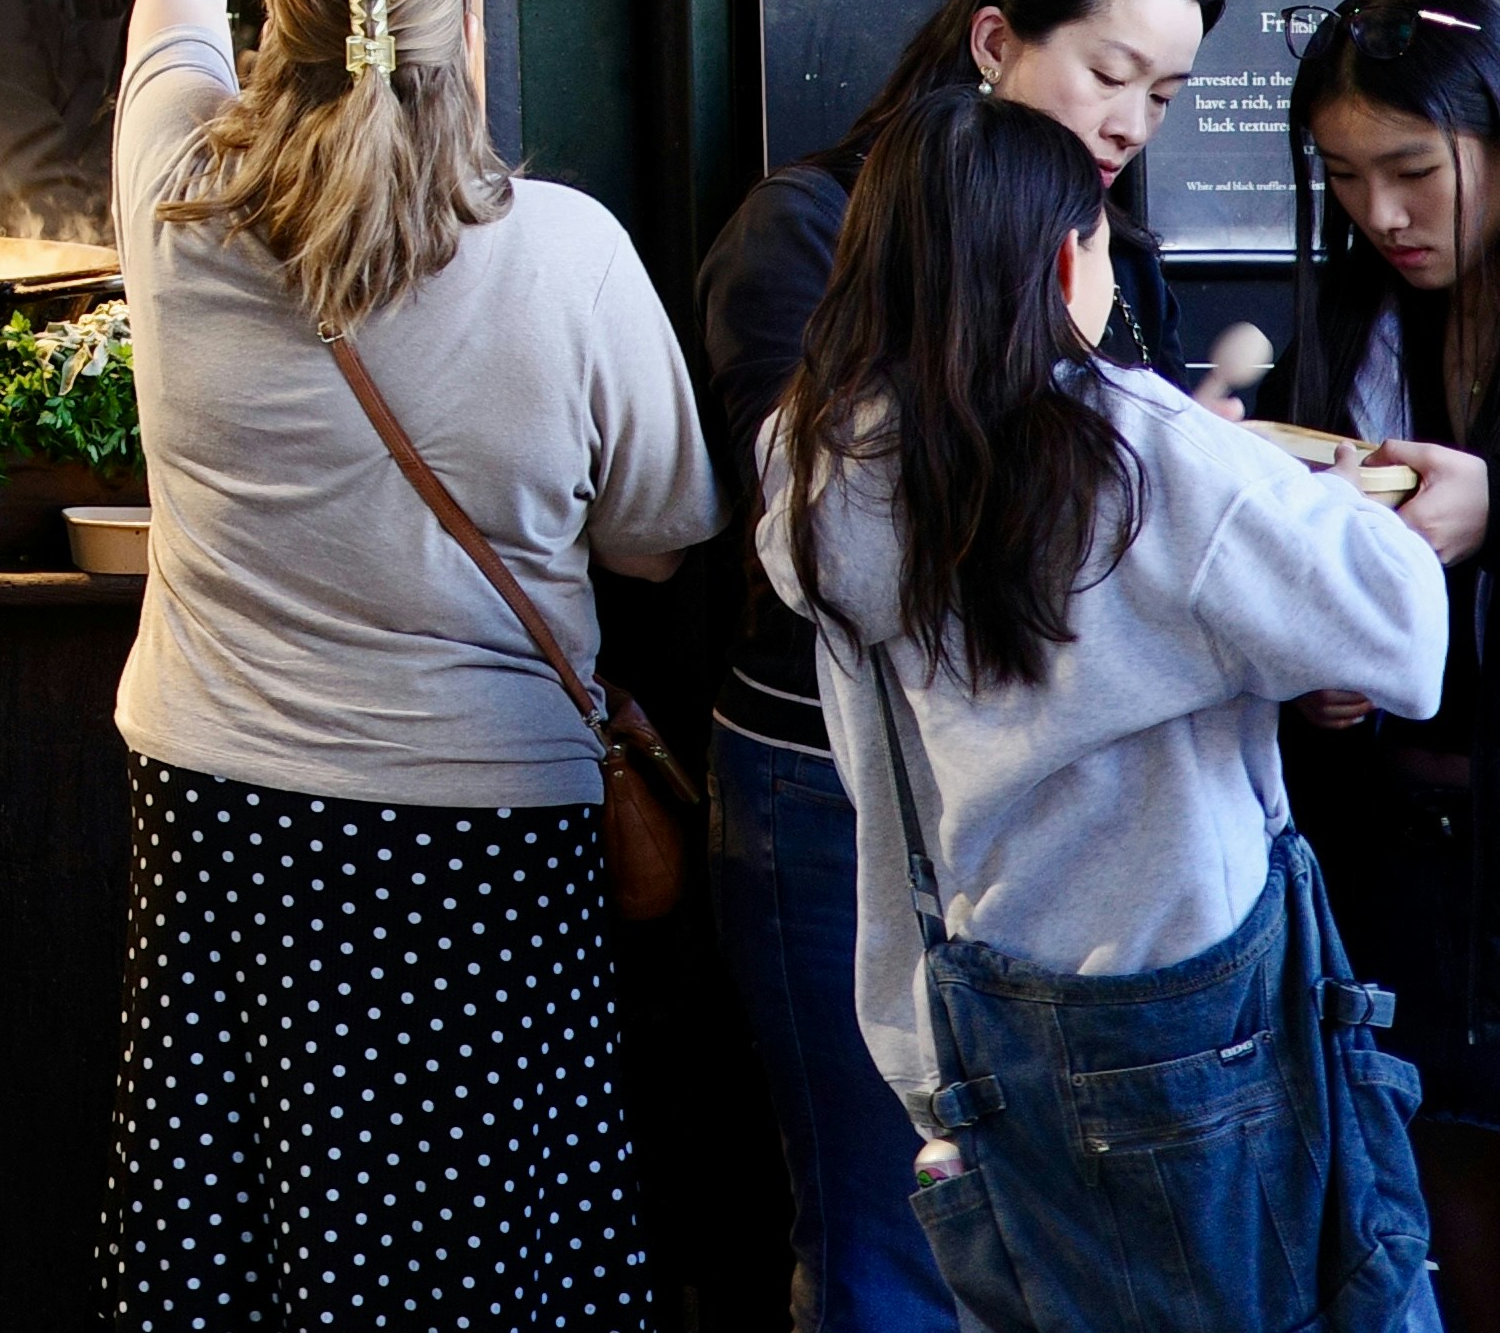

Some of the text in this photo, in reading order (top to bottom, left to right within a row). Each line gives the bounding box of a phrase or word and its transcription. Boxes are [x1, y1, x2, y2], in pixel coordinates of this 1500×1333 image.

[1252, 71, 1266, 86] in
[1269, 71, 1293, 86] the
[1195, 94, 1226, 110] have
[1229, 99, 1239, 110] a
[1241, 94, 1273, 111] rich,
[1198, 117, 1236, 133] black
[1186, 181, 1214, 191] White
[1215, 181, 1232, 191] and
[1232, 181, 1255, 191] black
[1256, 180, 1287, 191] truffles
